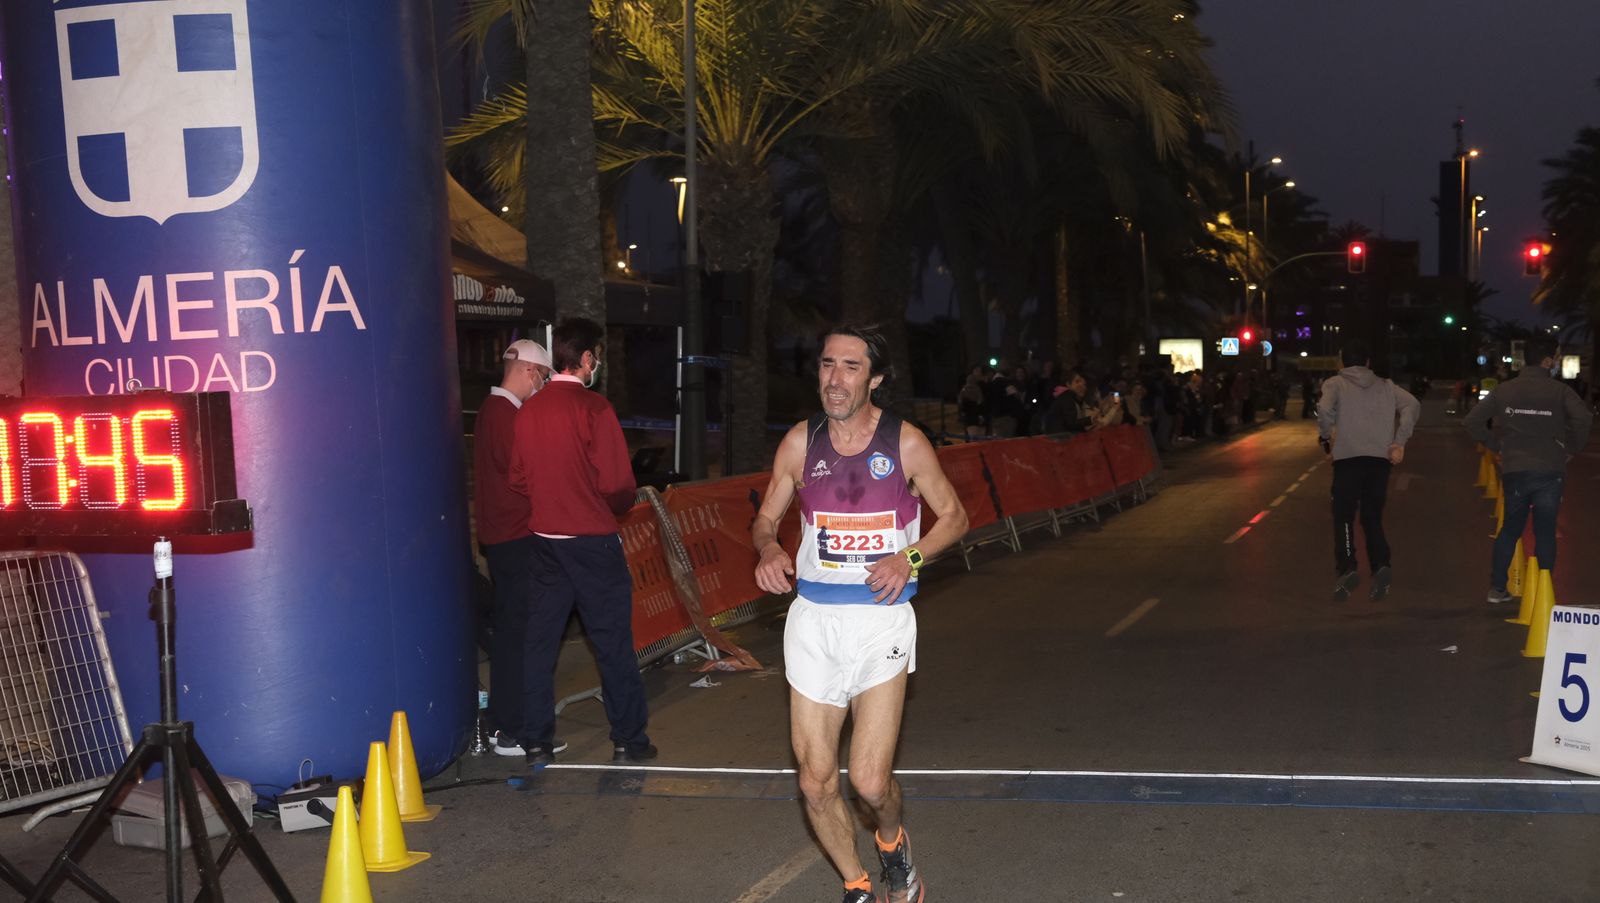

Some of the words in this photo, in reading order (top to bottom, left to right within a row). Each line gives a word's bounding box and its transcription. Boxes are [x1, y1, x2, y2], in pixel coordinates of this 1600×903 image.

[32, 250, 366, 347] ALMERÍA
[84, 351, 276, 395] CIUDAD
[830, 534, 884, 551] 3223
[846, 554, 856, 563] SEB
[1553, 611, 1600, 626] MONDO
[1558, 652, 1590, 723] 5
